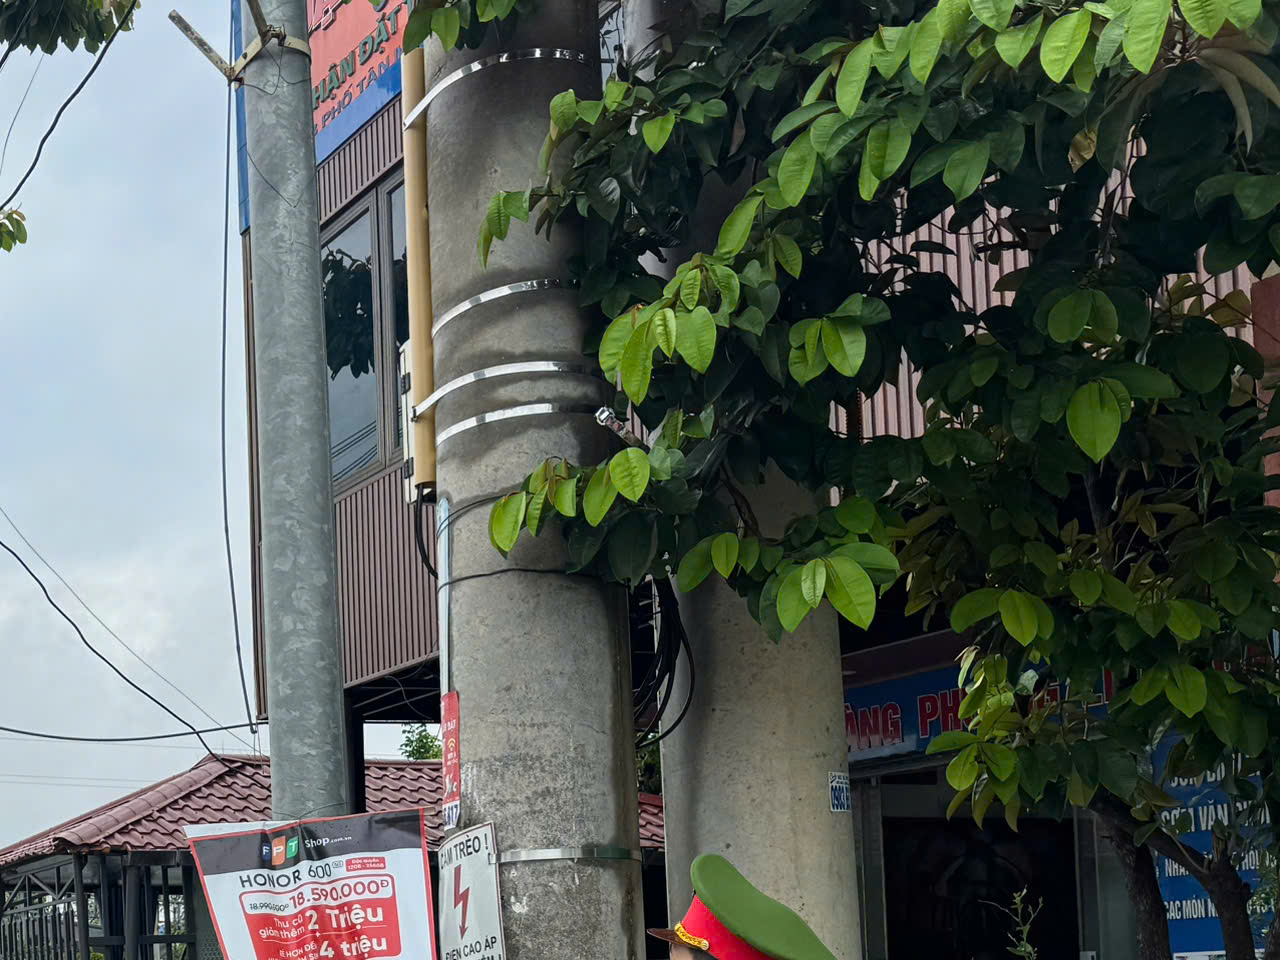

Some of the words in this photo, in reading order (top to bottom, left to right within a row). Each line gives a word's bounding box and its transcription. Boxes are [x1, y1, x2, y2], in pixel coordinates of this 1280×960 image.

[844, 702, 904, 751] ÀNG
[262, 837, 299, 862] FPT
[453, 834, 481, 861] TRÈO
[239, 868, 302, 889] HONOR
[307, 863, 332, 879] 600
[304, 909, 320, 931] 2
[325, 903, 384, 930] Triệu
[280, 926, 306, 939] thêm
[319, 940, 335, 959] 4
[340, 934, 388, 959] triệu
[462, 940, 482, 957] CAO
